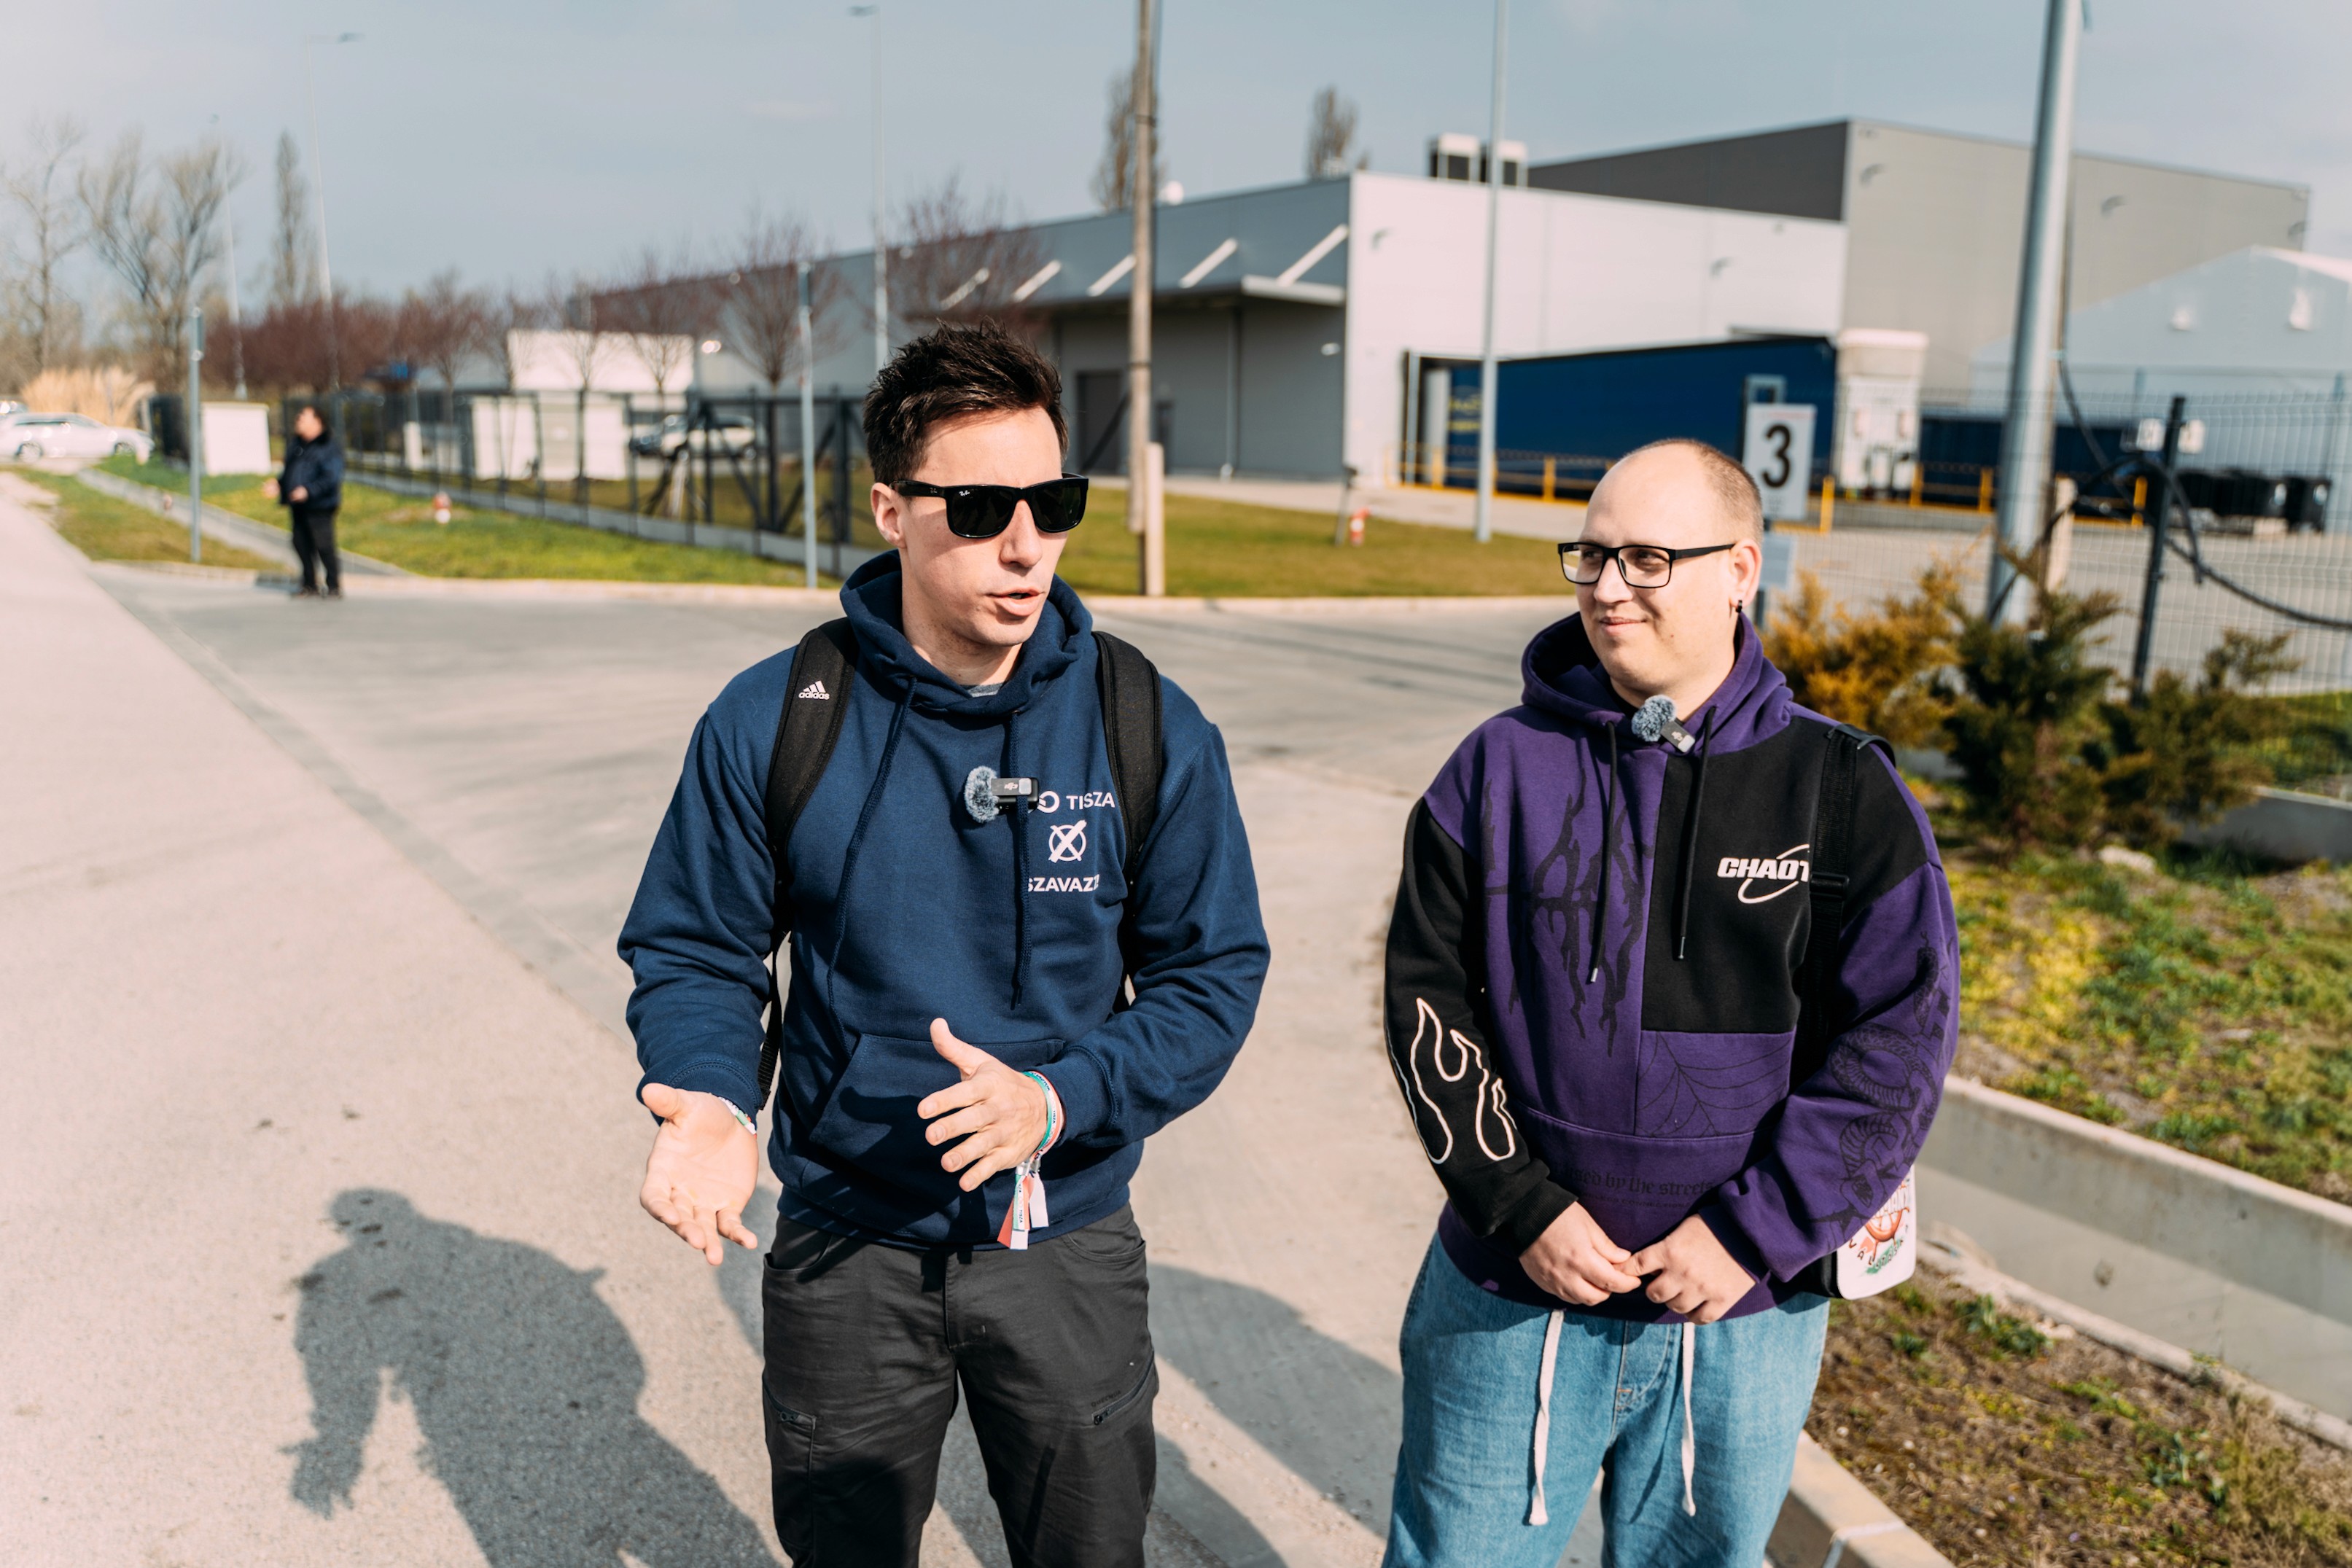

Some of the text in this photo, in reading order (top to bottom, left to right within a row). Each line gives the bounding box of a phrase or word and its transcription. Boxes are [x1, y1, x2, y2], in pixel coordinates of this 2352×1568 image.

[1762, 424, 1791, 488] 3
[798, 692, 830, 700] adidas
[1066, 791, 1115, 811] TISZA
[1605, 1171, 1626, 1192] by
[1629, 1177, 1654, 1195] the
